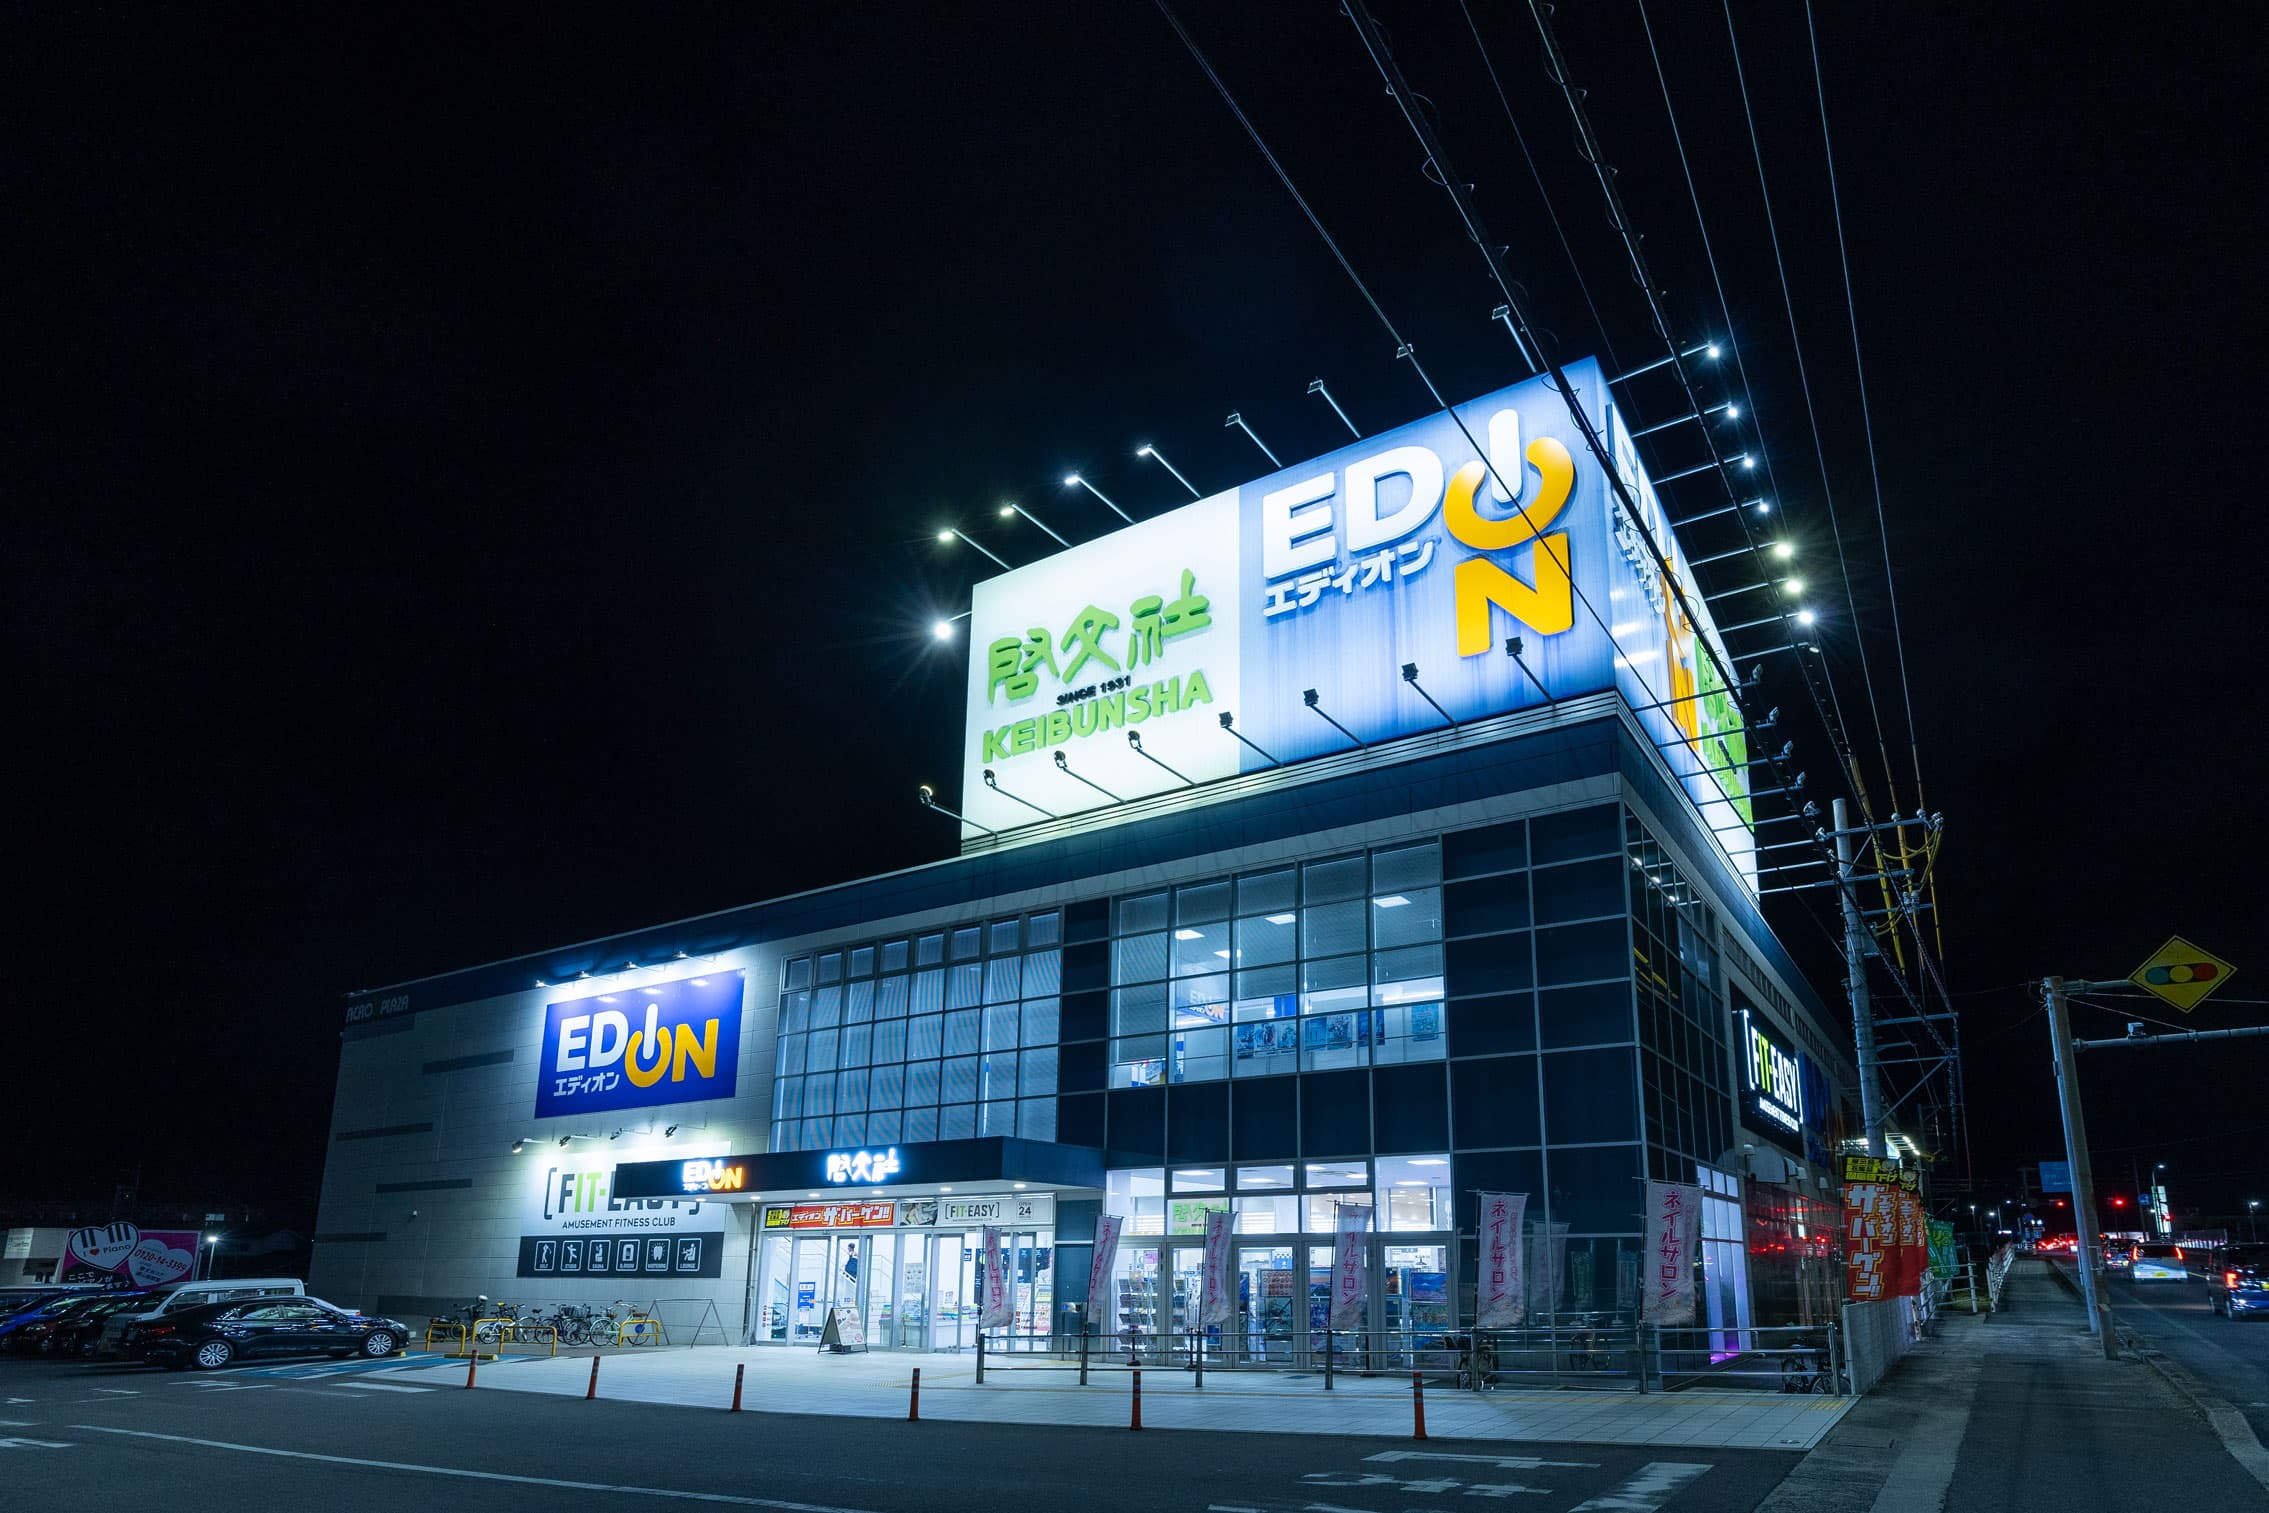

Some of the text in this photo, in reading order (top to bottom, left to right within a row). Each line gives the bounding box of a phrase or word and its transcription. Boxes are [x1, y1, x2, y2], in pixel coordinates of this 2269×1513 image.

[1262, 408, 1574, 658] EDION
[1263, 537, 1435, 617] エディオン
[982, 669, 1212, 763] KEIBUNSHA
[1056, 675, 1131, 706] SINCE 1931
[555, 1003, 720, 1088] EDION
[553, 1071, 620, 1096] エディオン
[682, 1160, 743, 1190] EDION
[562, 1216, 676, 1229] AMUSEMENT FITNESS CLUB
[1018, 1206, 1032, 1216] 24
[1878, 1194, 1895, 1245] エディオン
[103, 1244, 131, 1253] Piano
[1488, 1199, 1507, 1305] ネイルサロン
[1660, 1190, 1682, 1300] ネイルサロン
